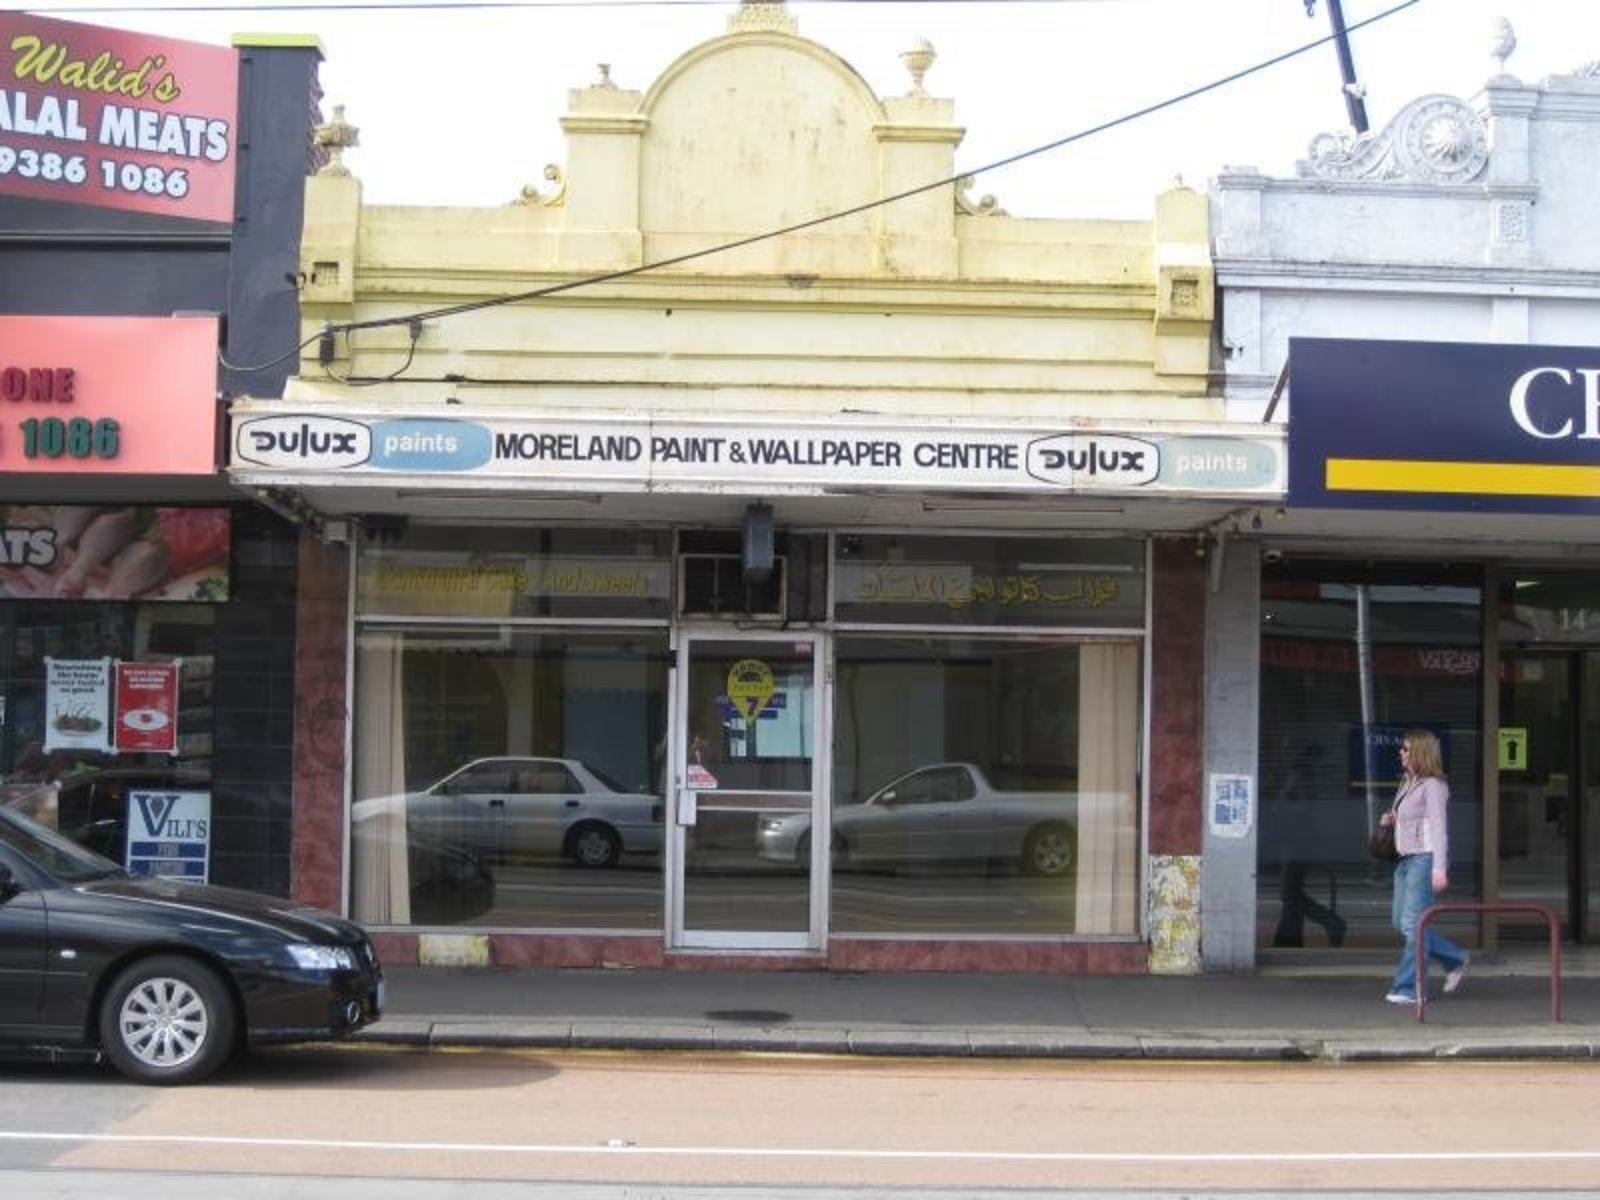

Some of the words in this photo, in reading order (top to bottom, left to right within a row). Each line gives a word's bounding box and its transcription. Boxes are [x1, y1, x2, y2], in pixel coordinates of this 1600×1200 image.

[11, 35, 181, 102] Walid's
[100, 104, 229, 161] MEATS
[0, 146, 87, 183] 9386
[101, 161, 189, 197] 1086
[2, 367, 76, 402] ONE
[20, 416, 121, 459] 1086
[384, 432, 459, 456] paints
[495, 433, 642, 462] MORELAND
[651, 437, 726, 463] PAINT
[729, 441, 748, 464] &
[748, 439, 902, 467] WALLPAPER
[913, 443, 1019, 469] CENTRE
[1176, 453, 1248, 475] paints
